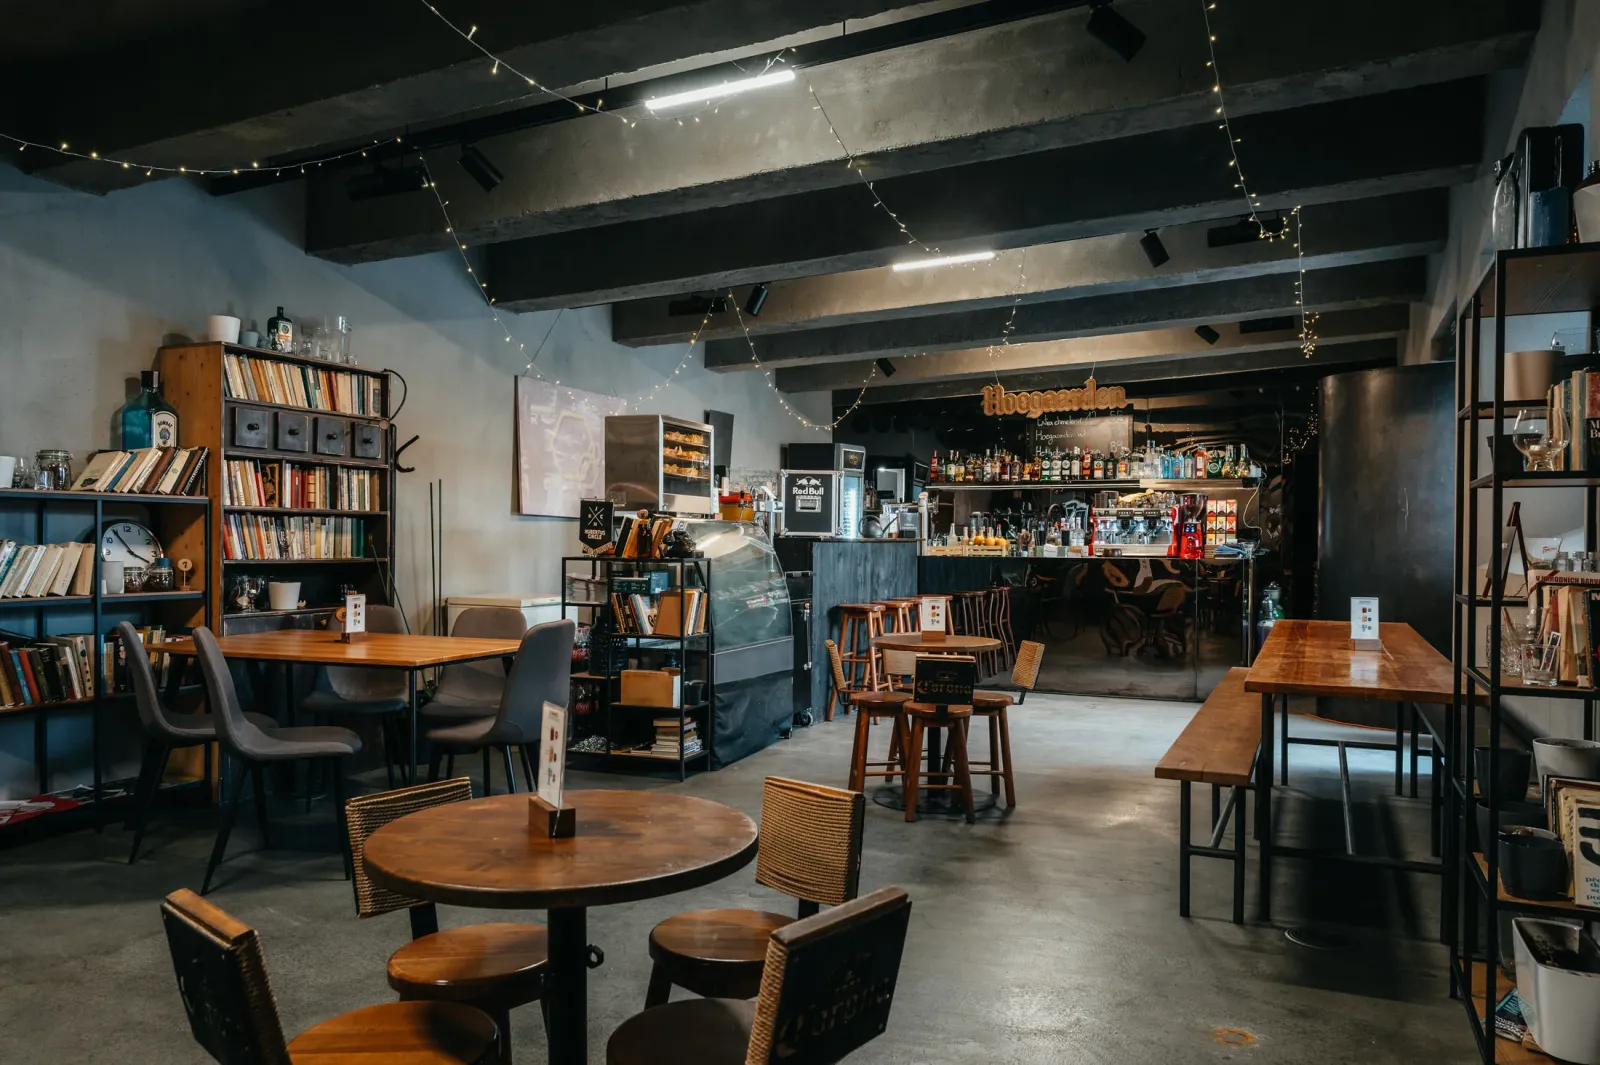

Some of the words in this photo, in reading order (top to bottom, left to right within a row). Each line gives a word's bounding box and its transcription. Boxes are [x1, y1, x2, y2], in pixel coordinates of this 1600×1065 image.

[981, 379, 1128, 418] Hoegaarden
[792, 487, 808, 495] Red
[809, 487, 824, 495] Bull
[917, 680, 972, 694] Corona
